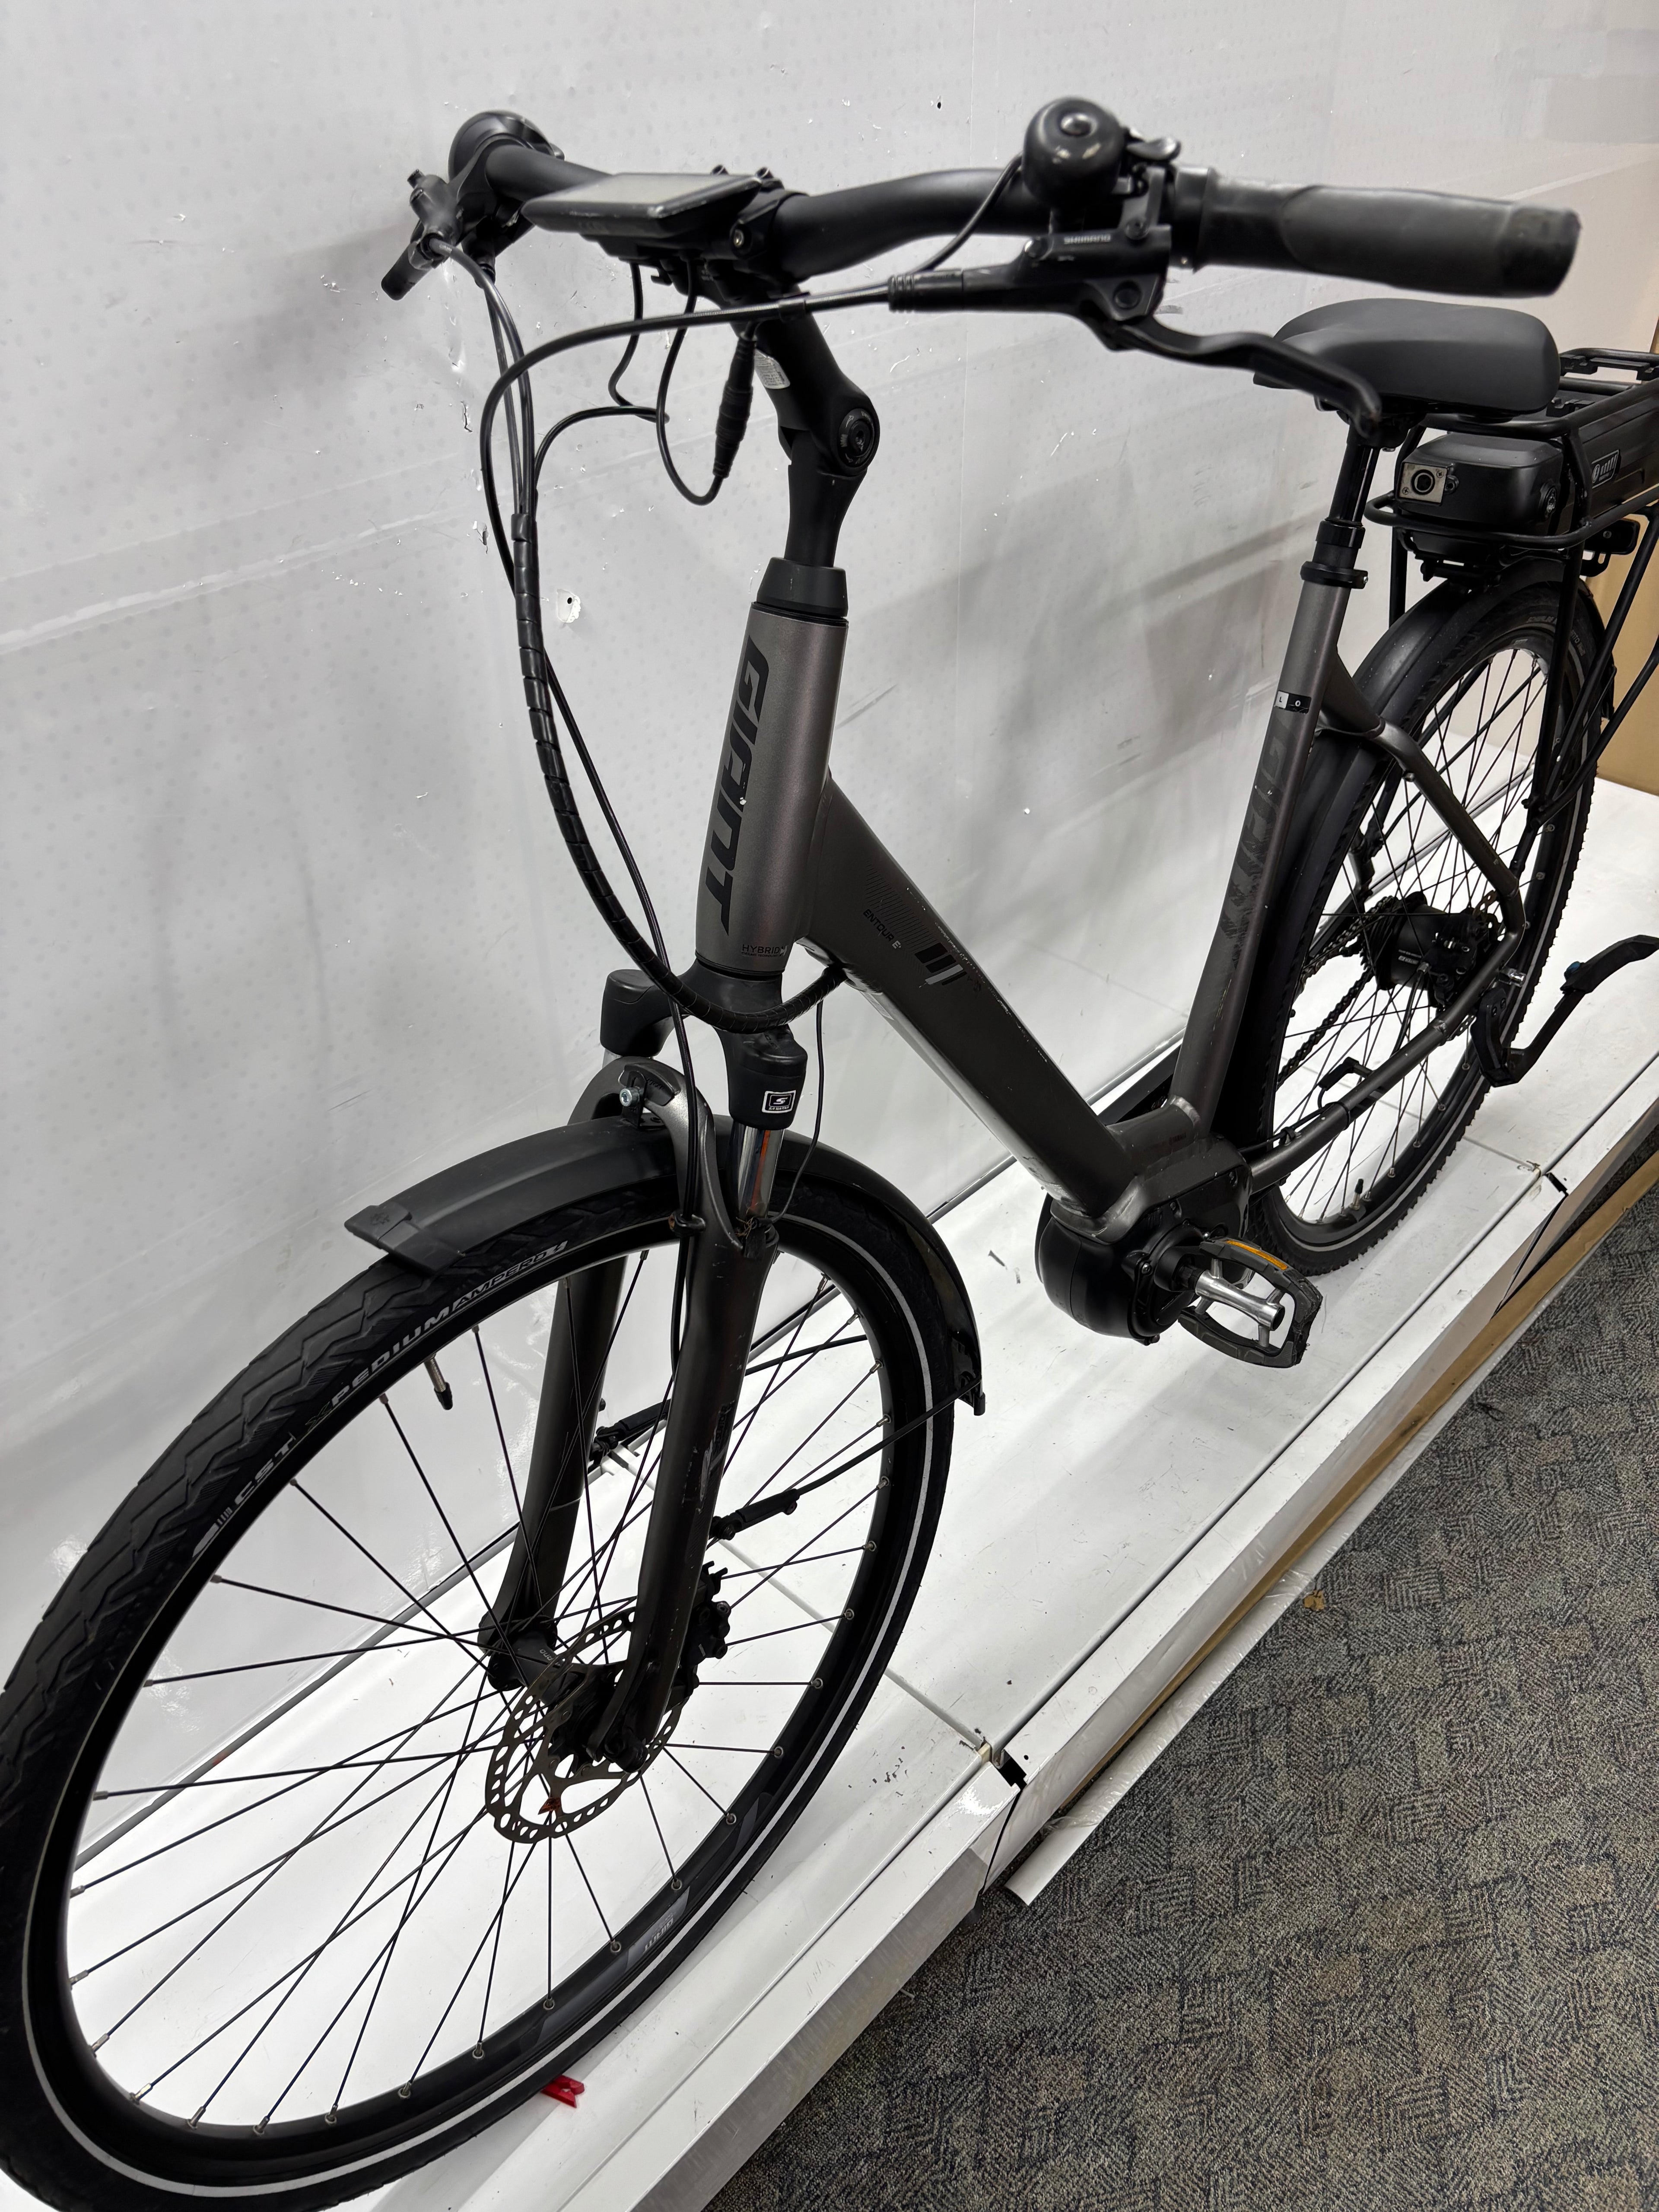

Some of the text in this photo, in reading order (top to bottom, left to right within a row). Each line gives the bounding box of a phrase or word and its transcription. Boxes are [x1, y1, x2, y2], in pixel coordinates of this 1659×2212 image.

[706, 635, 769, 937] GIANT
[742, 944, 780, 954] HYBRID
[863, 909, 895, 942] ENTOUR
[235, 1435, 294, 1505] CST
